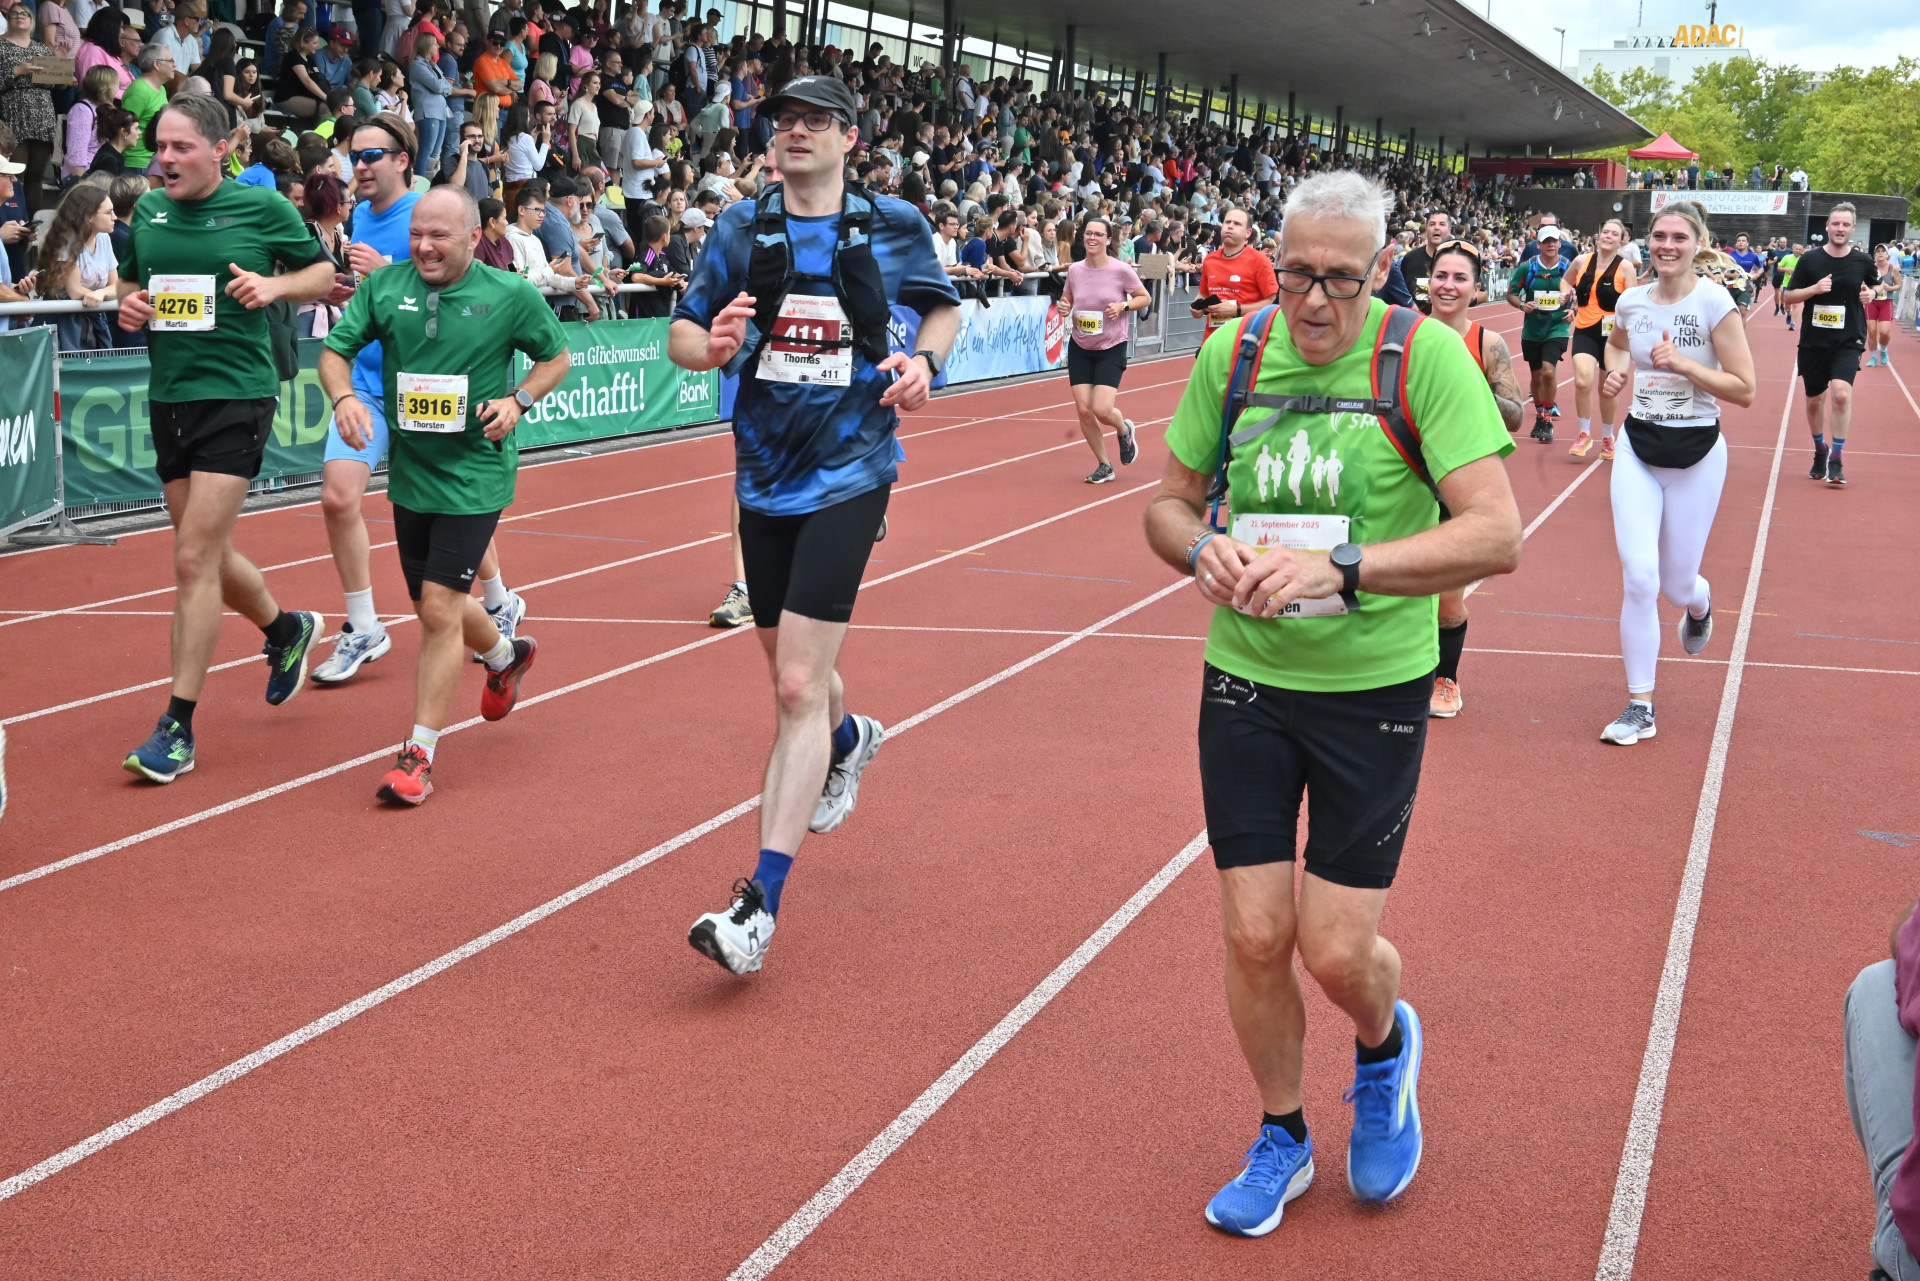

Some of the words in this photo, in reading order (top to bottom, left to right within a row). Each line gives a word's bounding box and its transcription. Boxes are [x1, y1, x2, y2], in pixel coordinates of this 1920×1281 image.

[1673, 24, 1737, 46] ADAC
[1708, 204, 1757, 212] TATHLETIK
[159, 299, 198, 315] 4276
[1539, 298, 1556, 306] 2124
[1673, 314, 1699, 328] ENGEL
[1819, 314, 1838, 323] 6025
[165, 320, 188, 328] Martin
[1078, 320, 1096, 329] 7490
[783, 324, 824, 347] 411
[587, 340, 660, 366] Glückwunsch!
[784, 353, 821, 365] Thomas
[821, 369, 839, 379] 411
[680, 379, 709, 404] Bank
[1639, 388, 1686, 397] Marathonengel
[409, 398, 452, 416] 3916
[1336, 401, 1364, 409] CAMELBAK
[1645, 412, 1664, 421] Cindy
[413, 420, 446, 429] Thorsten
[1250, 520, 1259, 528] 21.
[1261, 521, 1299, 530] September
[1301, 521, 1320, 529] 2025
[1392, 724, 1414, 734] JAKO
